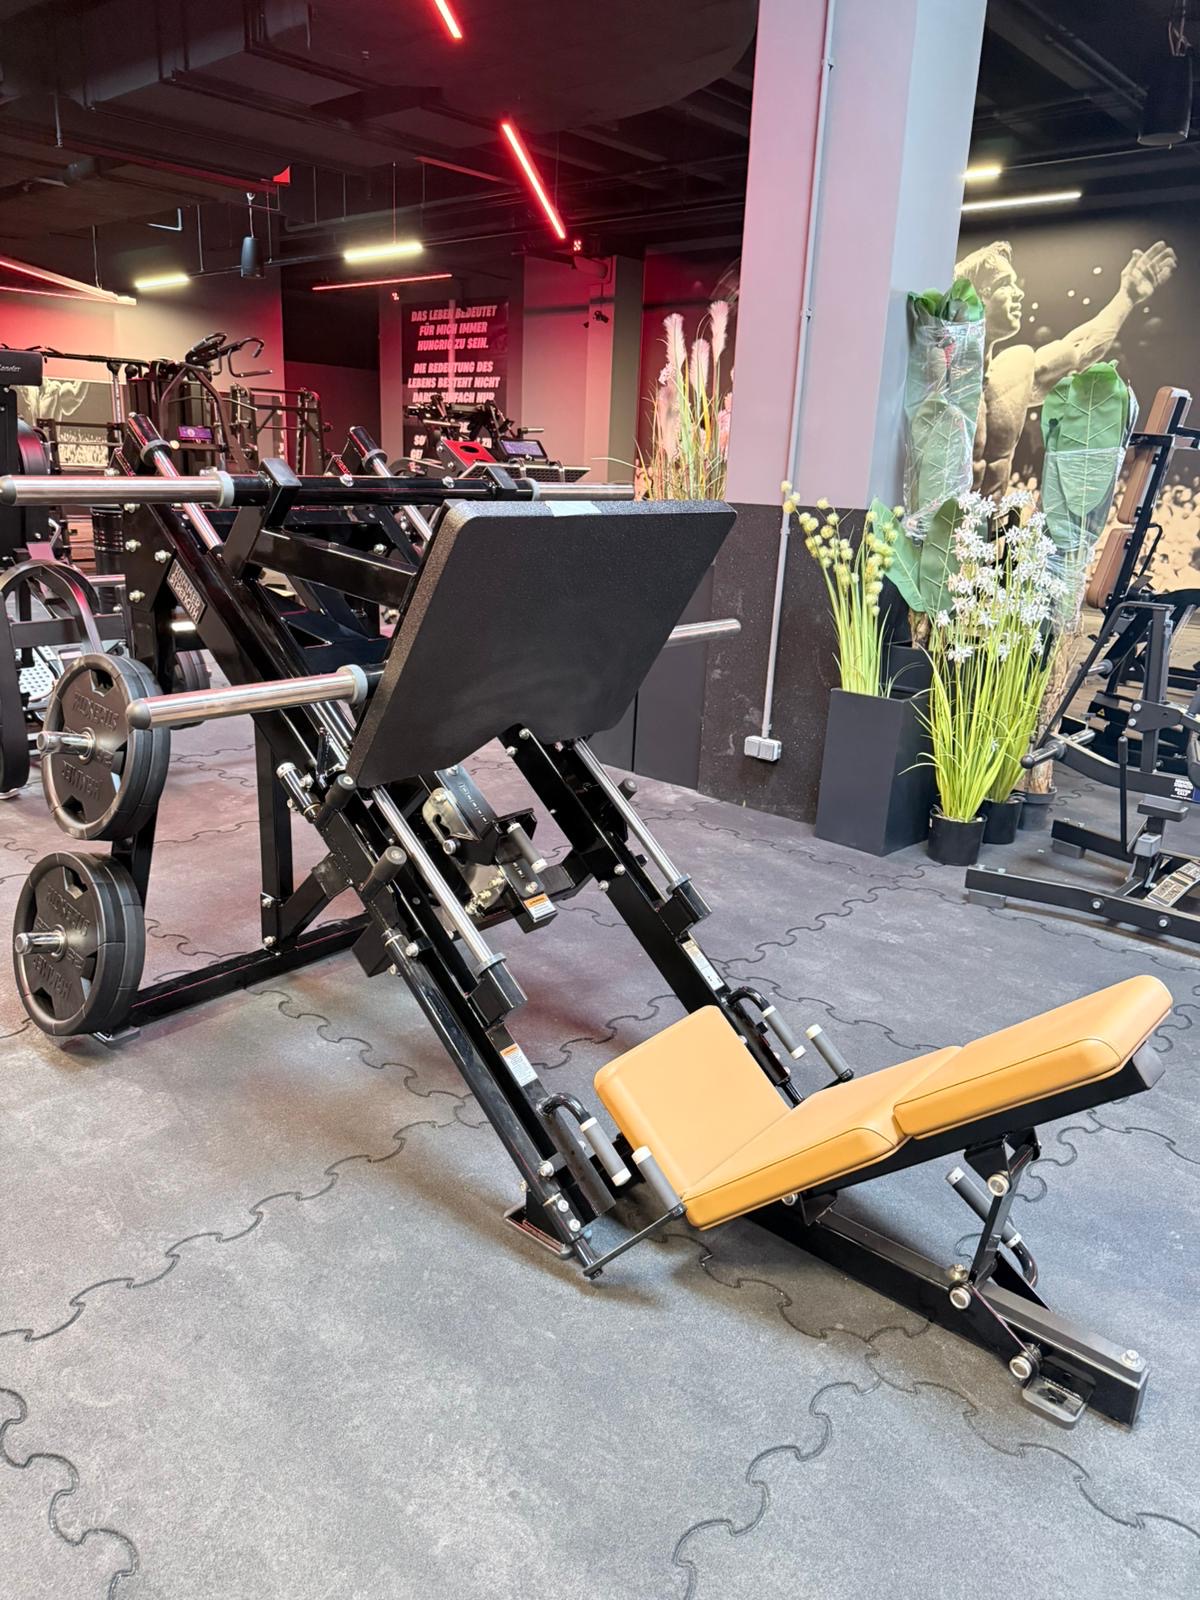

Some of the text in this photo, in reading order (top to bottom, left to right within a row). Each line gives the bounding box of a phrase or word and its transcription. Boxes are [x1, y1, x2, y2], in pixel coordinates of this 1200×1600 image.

[411, 310, 428, 322] DAS
[429, 308, 455, 320] LEBEN
[419, 322, 488, 336] FÜR MICH IMMER
[417, 337, 489, 351] HUNGRIG ZU SEIN.
[413, 361, 494, 374] DIE BEDEUTUNG DES
[407, 376, 501, 388] LEBENS BESTEHT NICHT
